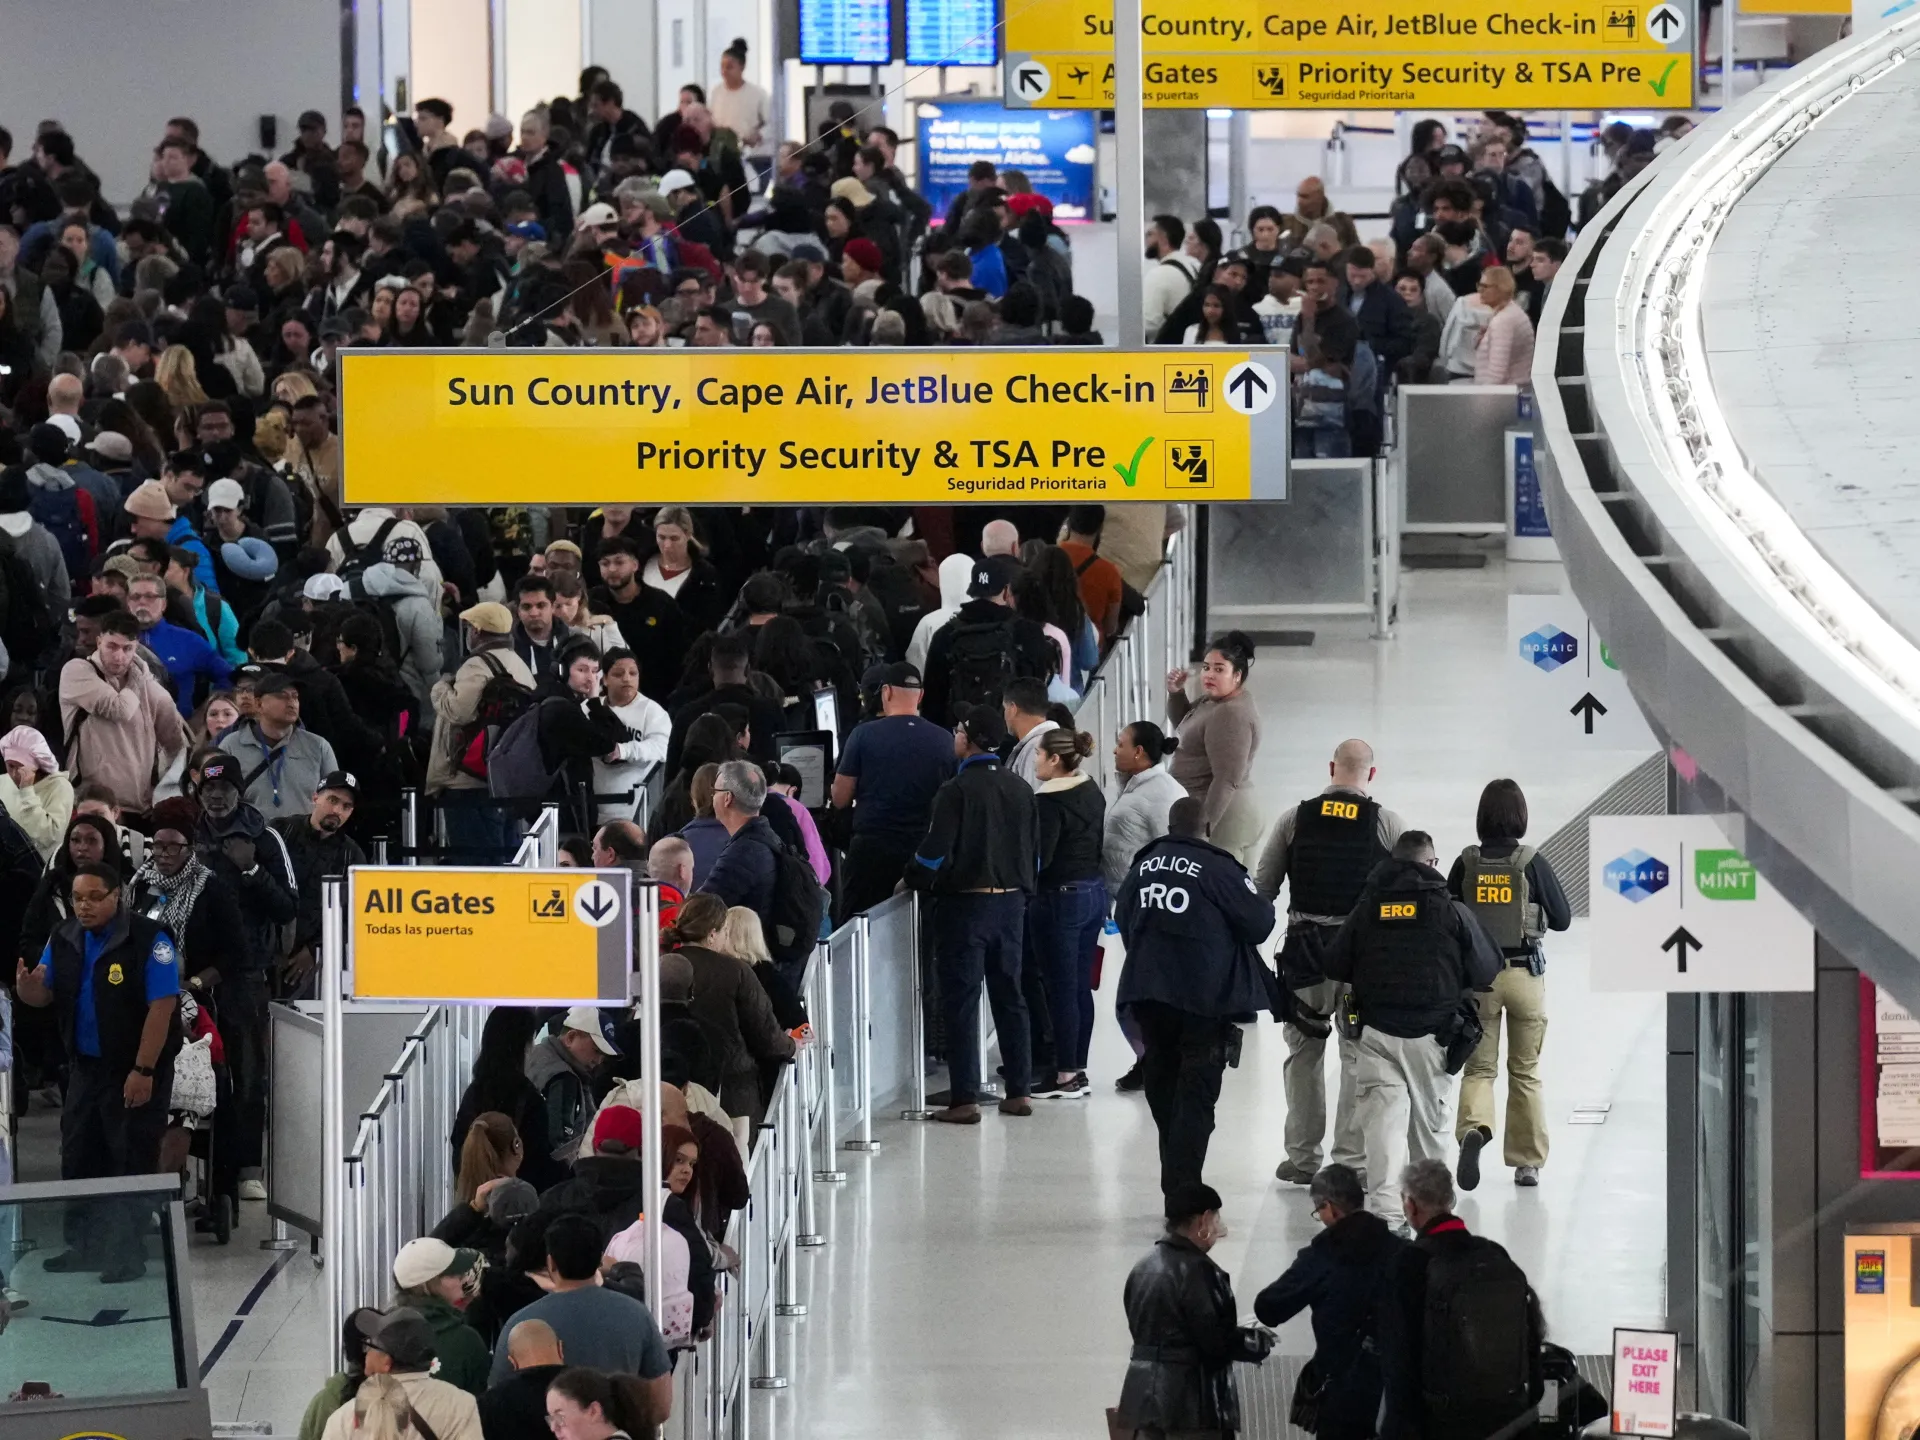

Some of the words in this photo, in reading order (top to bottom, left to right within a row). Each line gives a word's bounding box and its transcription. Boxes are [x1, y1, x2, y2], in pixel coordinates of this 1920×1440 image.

[1084, 14, 1114, 36] Su
[1141, 14, 1252, 42] Country,
[1264, 14, 1327, 41] Cape
[1336, 13, 1378, 38] Air,
[1384, 13, 1477, 36] JetBlue
[1486, 13, 1596, 36] Check-in
[1145, 62, 1218, 84] Gates
[1299, 61, 1393, 89] Priority
[1402, 61, 1505, 89] Security
[1515, 62, 1533, 83] &
[1541, 62, 1593, 83] TSA
[1601, 62, 1641, 83] Pre
[1156, 91, 1199, 102] puertas
[1298, 90, 1356, 102] Seguridad
[1358, 90, 1415, 100] Prioritaria
[448, 377, 514, 406] Sun
[527, 377, 681, 413] Country,
[696, 377, 784, 413] Cape
[795, 375, 853, 410] Air,
[865, 374, 993, 405] JetBlue
[1005, 373, 1155, 405] Check-in
[637, 440, 767, 478] Priority
[779, 440, 921, 478] Security
[933, 440, 959, 470] &
[969, 440, 1040, 469] TSA
[1051, 440, 1106, 469] Pre
[947, 476, 1025, 494] Seguridad
[1030, 476, 1107, 491] Prioritaria
[1523, 643, 1574, 653] MOSAIC
[1321, 800, 1358, 820] ERO
[1139, 855, 1203, 878] POLICE
[1477, 874, 1511, 885] POLICE
[1607, 870, 1666, 882] MOSAIC
[1700, 871, 1752, 889] MINT
[364, 887, 403, 914] All
[411, 888, 495, 915] Gates
[1476, 886, 1513, 904] ERO
[1380, 903, 1416, 918] ERO
[366, 923, 401, 935] Todas
[405, 923, 422, 935] las
[426, 925, 474, 938] puertas
[1622, 1346, 1669, 1362] PLEASE
[1631, 1363, 1658, 1378] EXIT
[1628, 1380, 1661, 1395] HERE
